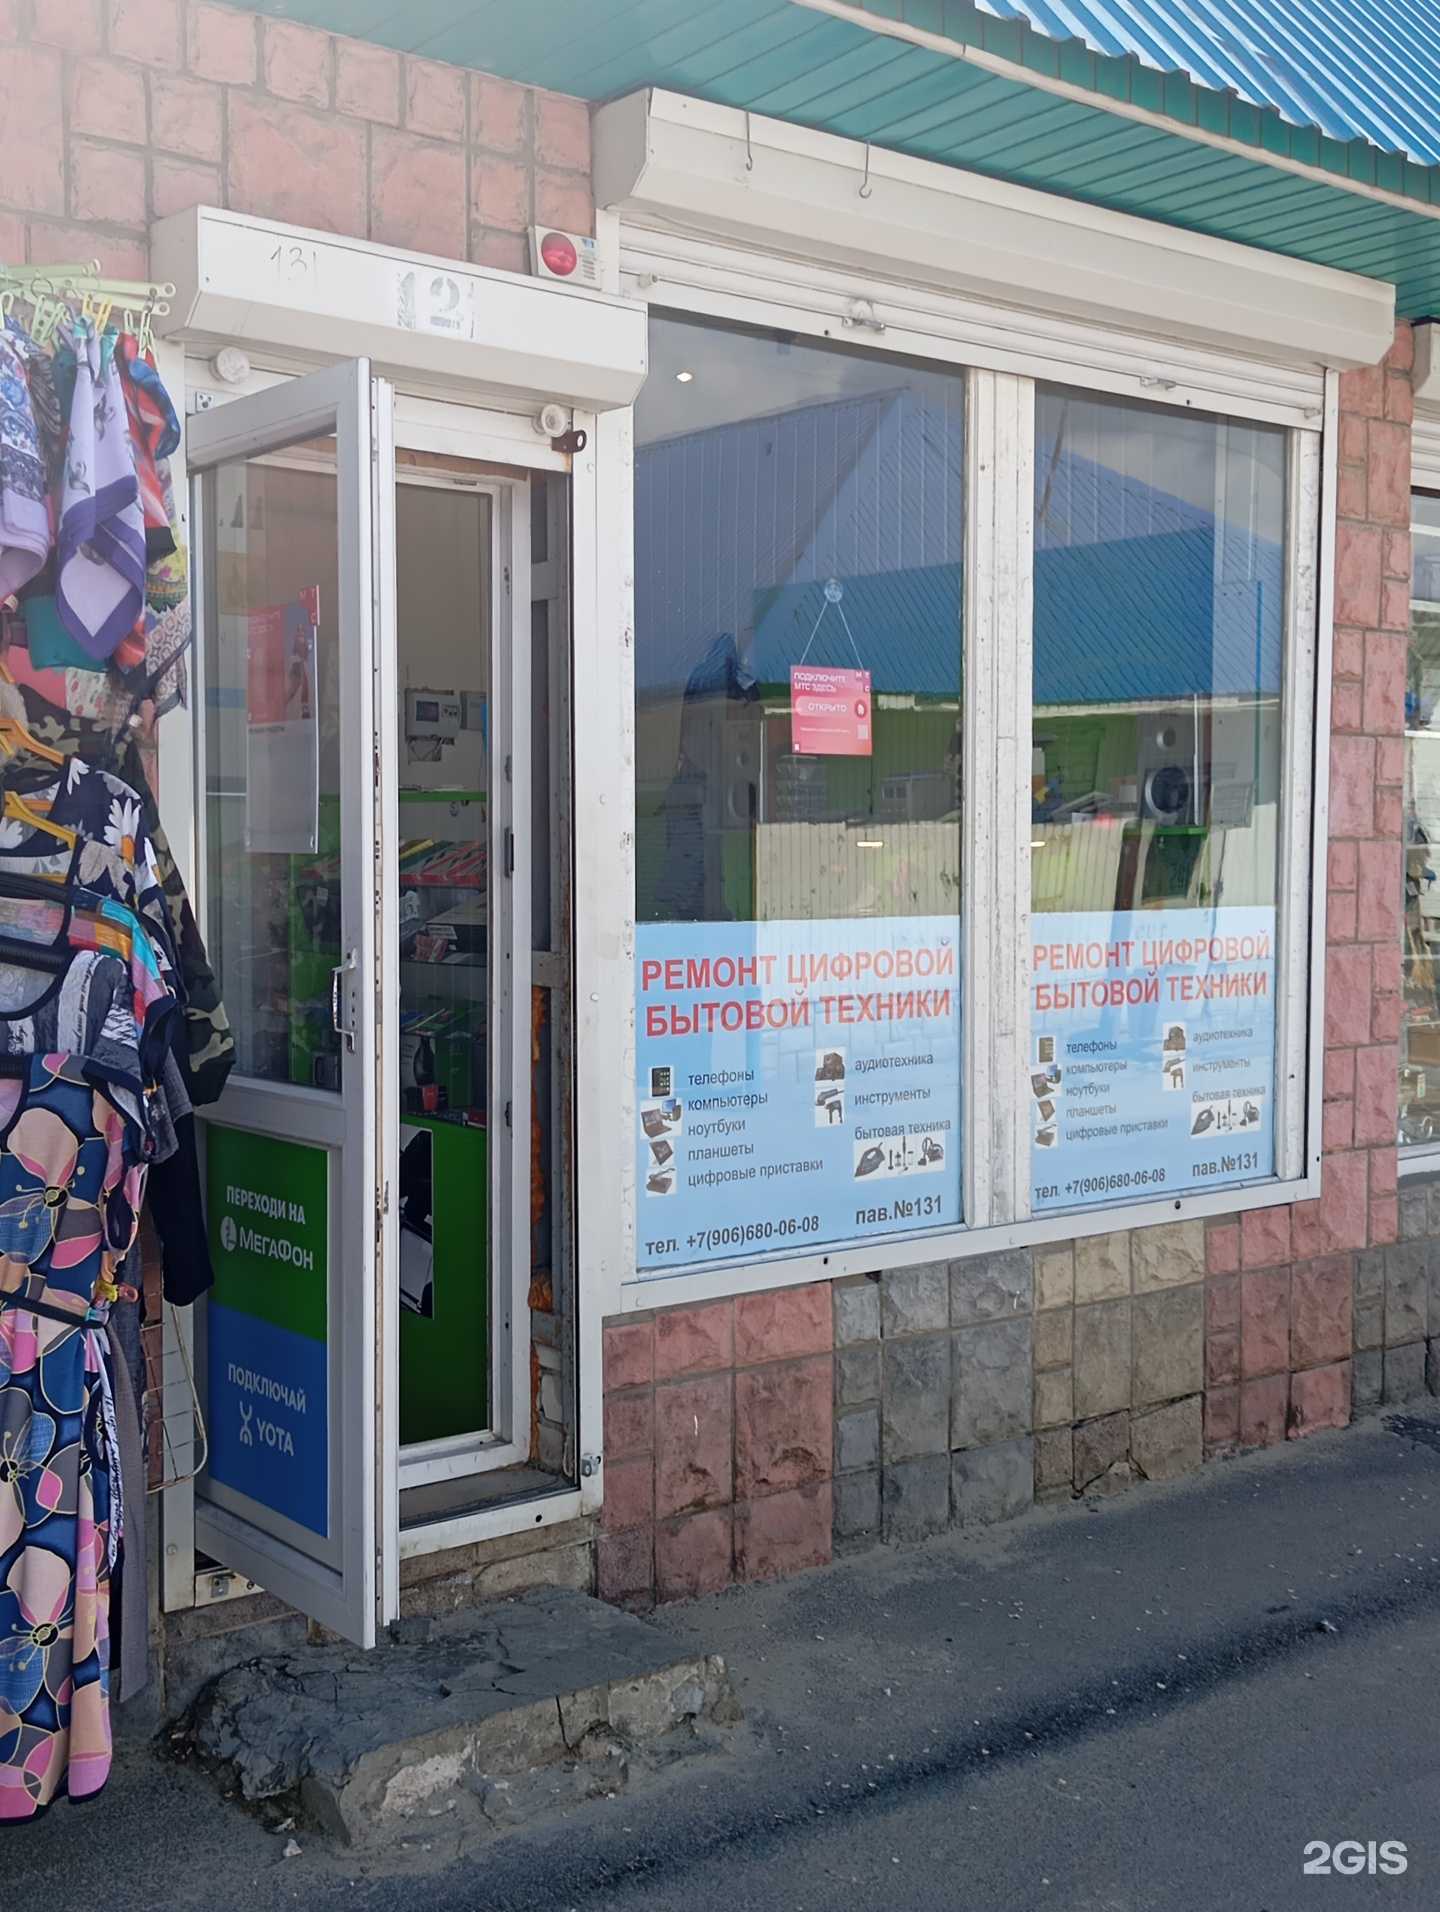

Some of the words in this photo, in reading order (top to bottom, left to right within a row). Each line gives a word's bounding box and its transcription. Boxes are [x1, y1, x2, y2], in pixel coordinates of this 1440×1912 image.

[1032, 940, 1135, 971] РЕМОНТ
[1142, 929, 1270, 970] ЦИФРОВОЙ
[641, 955, 778, 992] РЕМОНТ
[787, 936, 954, 988] ЦИФРОВОЙ
[1035, 971, 1160, 1010] БЫТОВОЙ
[1166, 972, 1267, 1002] ТЕХНИКИ
[646, 988, 811, 1037] БЫТОВОЙ
[820, 989, 951, 1025] ТЕХНИКИ
[1066, 1040, 1118, 1055] телефоны
[855, 1054, 934, 1074] аудиотехника
[1066, 1061, 1128, 1075] компьютеры
[688, 1069, 755, 1087] телефоны
[854, 1088, 931, 1107] инструменты
[1066, 1082, 1110, 1099] ноутбуки
[1192, 1090, 1231, 1103] бытовая
[688, 1092, 768, 1112] компьютеры
[1066, 1104, 1117, 1118] планшеты
[688, 1119, 746, 1138] ноутбуки
[854, 1124, 905, 1141] бытовая
[908, 1119, 951, 1134] техника
[1066, 1125, 1118, 1142] цифровые
[688, 1143, 754, 1162] планшеты
[688, 1164, 756, 1188] цифровые
[760, 1158, 824, 1179] приставки
[1192, 1152, 1258, 1177] пав.№131
[1065, 1168, 1166, 1197] +7(906)680-06-08
[226, 1185, 286, 1219] ПЕРЕХОДИ
[288, 1202, 306, 1225] НА
[855, 1195, 943, 1225] пав.№131
[645, 1239, 680, 1256] тел.
[686, 1215, 820, 1251] +7(906)680-06-08
[228, 1363, 307, 1414] ПОДКЛЮЧАЙ
[256, 1417, 295, 1456] YOTA
